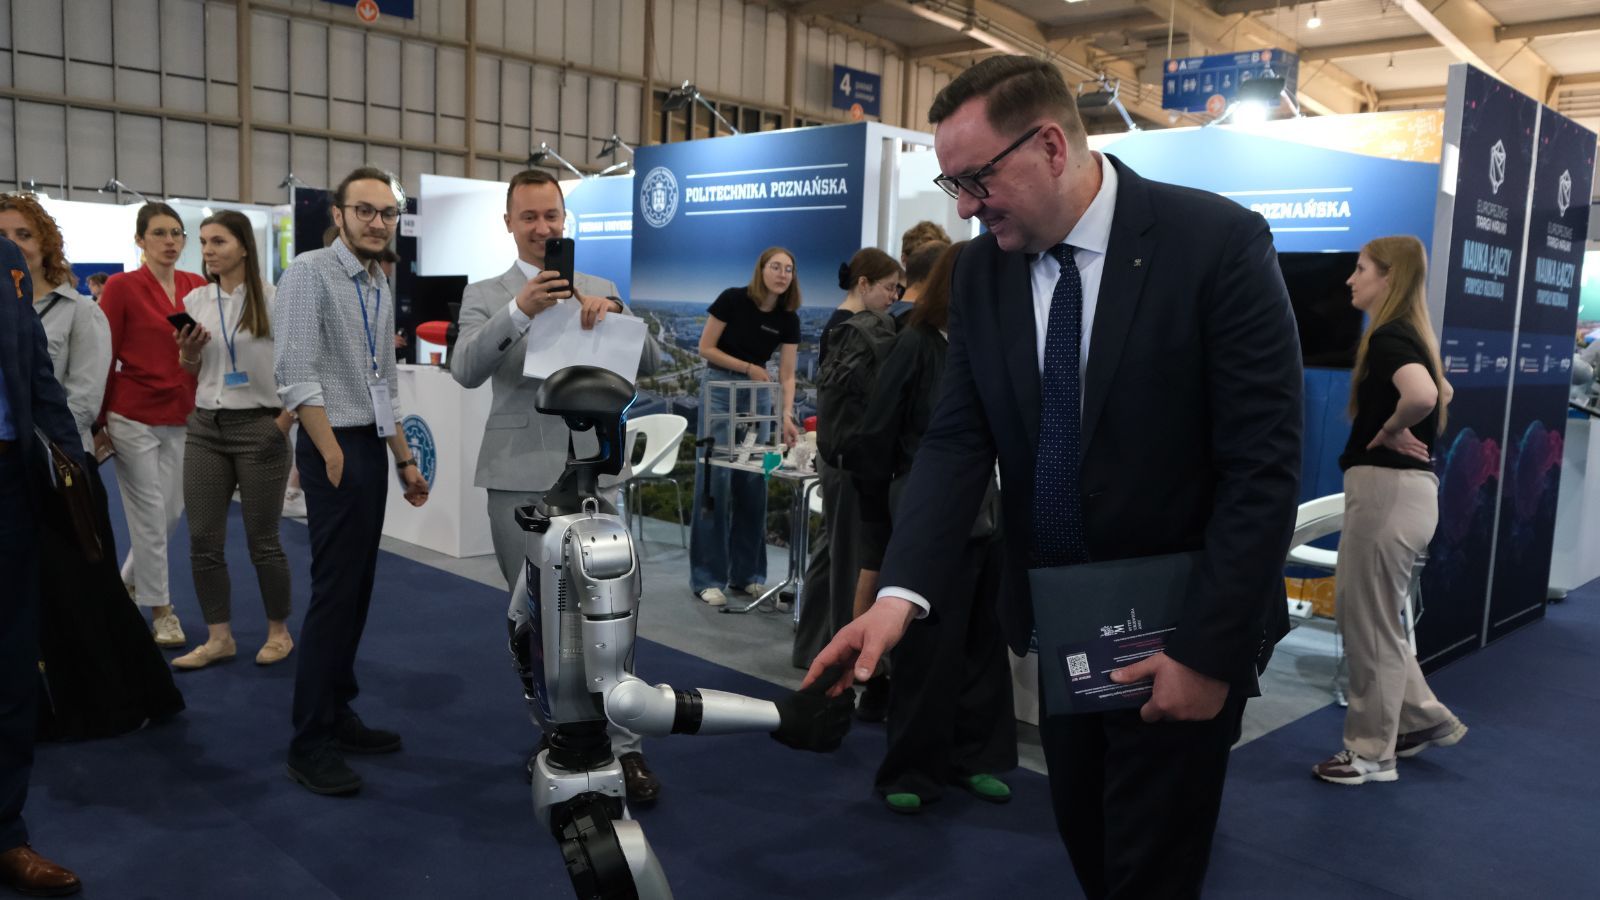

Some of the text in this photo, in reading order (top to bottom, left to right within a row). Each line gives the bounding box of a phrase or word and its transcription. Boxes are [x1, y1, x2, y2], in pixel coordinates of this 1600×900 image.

[840, 73, 851, 96] 4
[685, 176, 848, 203] POLITECHNIKA POZNAŃSKA
[1462, 239, 1512, 280] NAUKA ŁĄCZY
[1535, 256, 1576, 292] NAUKA ŁĄCZY
